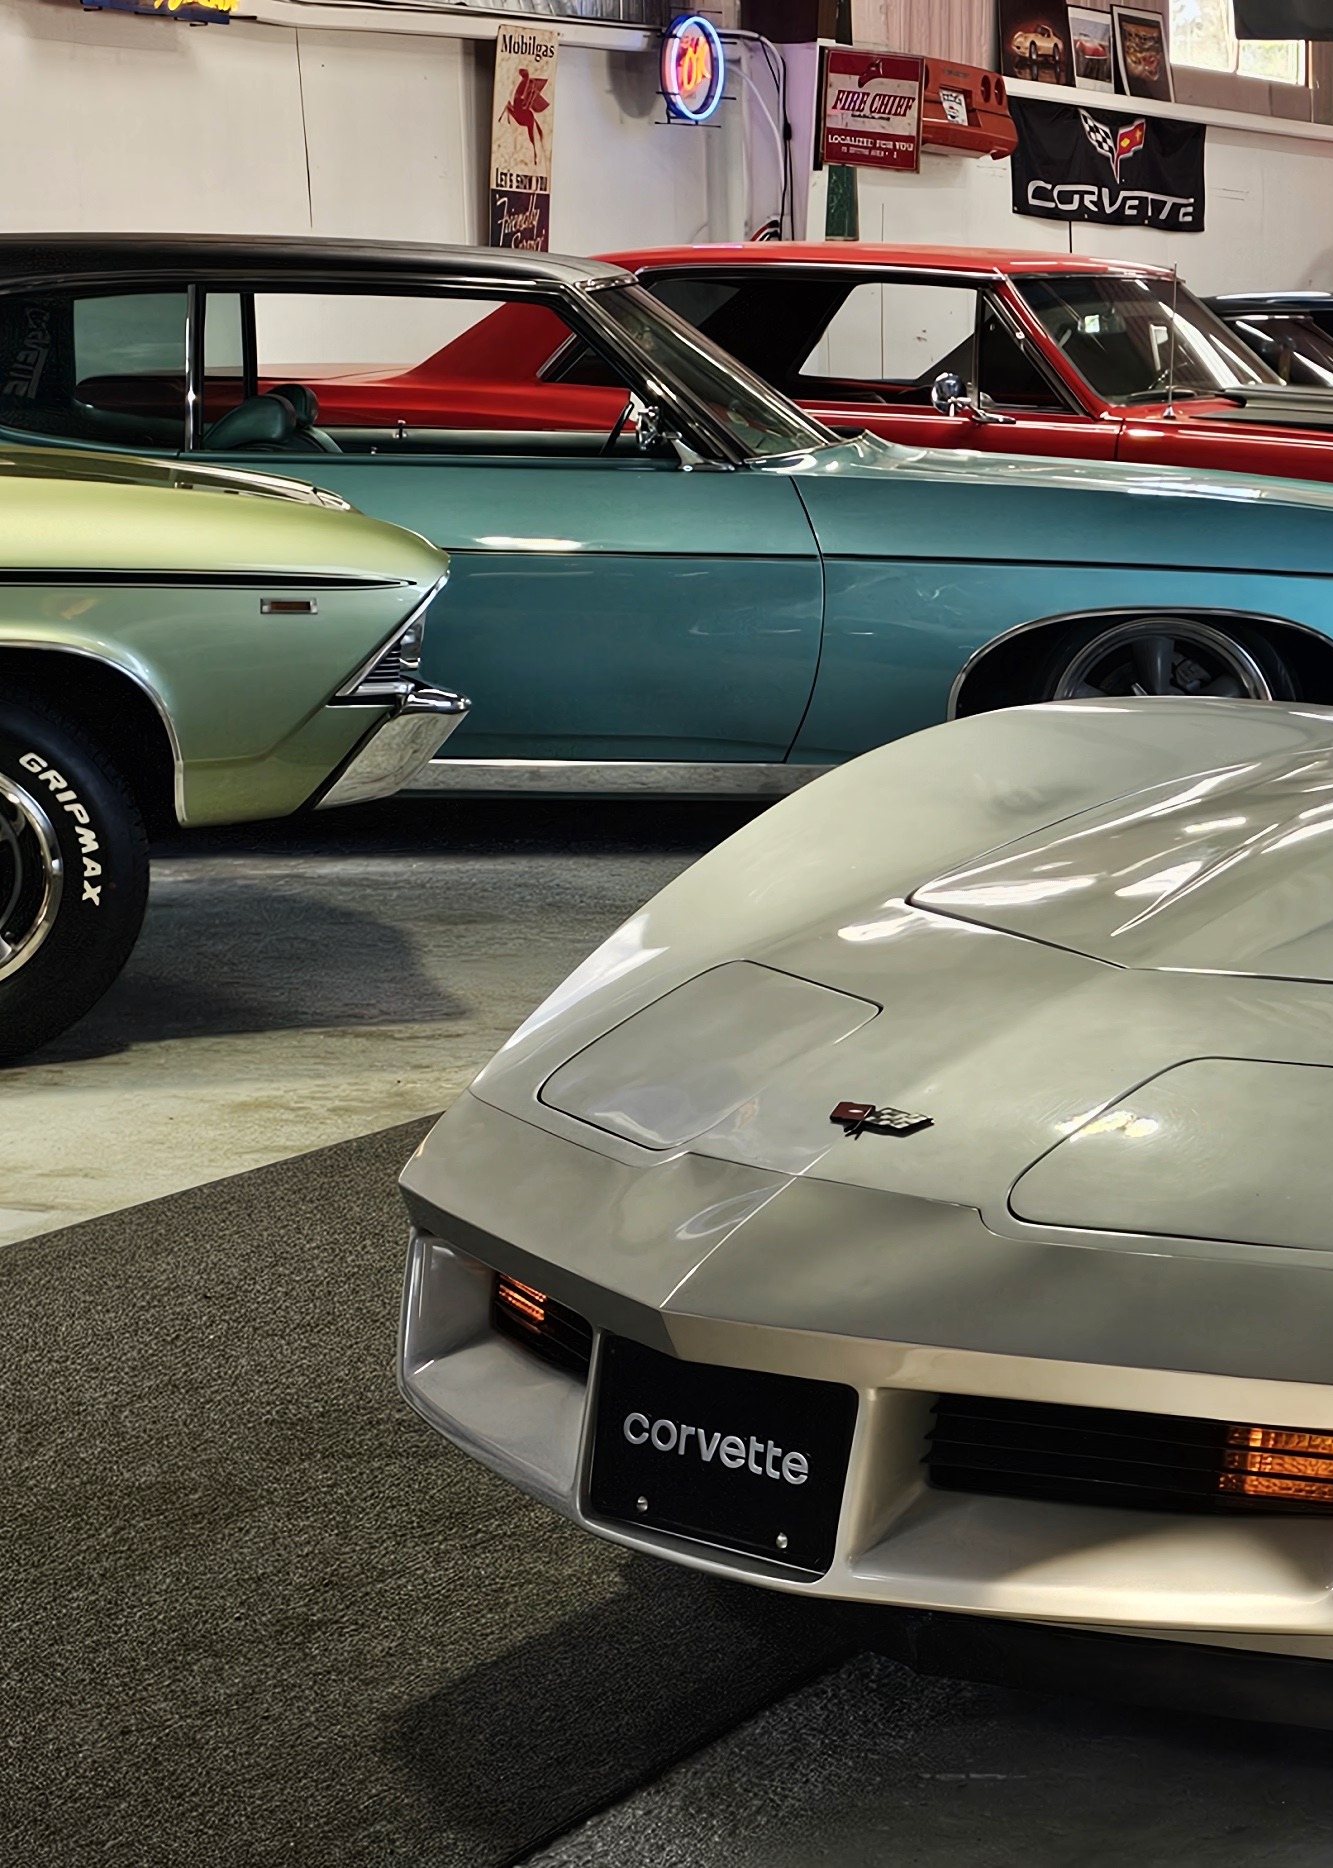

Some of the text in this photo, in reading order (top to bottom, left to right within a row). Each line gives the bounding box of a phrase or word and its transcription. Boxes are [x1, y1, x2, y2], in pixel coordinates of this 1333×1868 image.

[501, 34, 555, 62] Mobilgas
[832, 89, 871, 112] FIRE
[870, 93, 915, 116] CHIEF
[895, 141, 914, 151] YOU
[1028, 180, 1194, 222] CORVETTE
[18, 752, 102, 906] GRIPMAX
[623, 1412, 809, 1485] corvette
